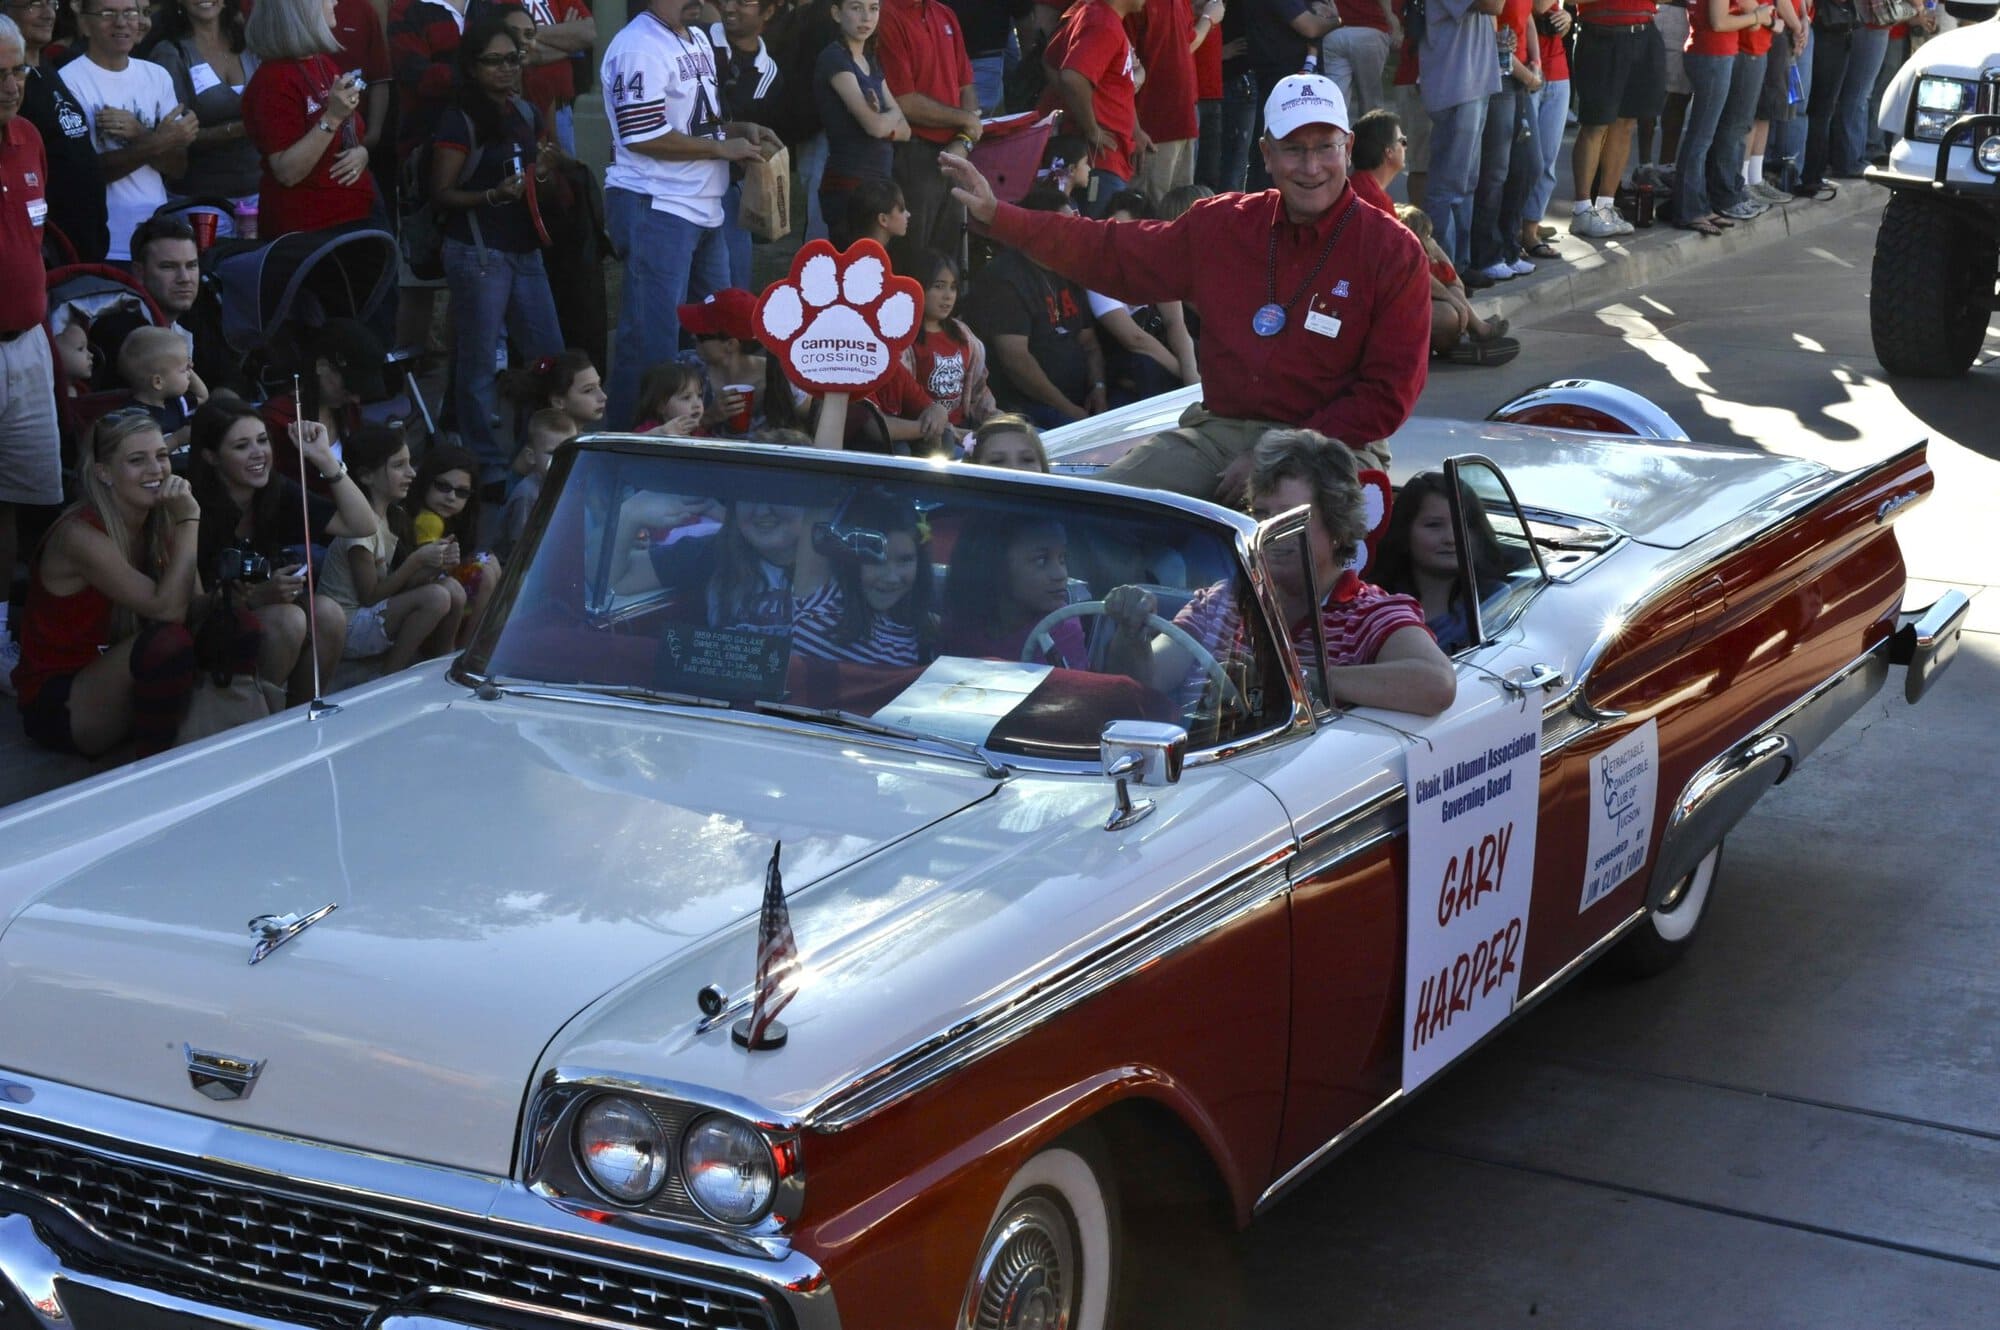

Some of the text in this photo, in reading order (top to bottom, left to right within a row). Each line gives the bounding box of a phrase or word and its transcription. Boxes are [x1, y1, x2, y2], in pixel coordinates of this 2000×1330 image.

[612, 70, 645, 102] 44
[801, 338, 865, 351] campus
[801, 350, 877, 367] crossings
[712, 632, 733, 642] FORD
[1443, 766, 1455, 792] UA
[1456, 751, 1487, 786] Alumni
[1487, 732, 1536, 771] Association
[1601, 741, 1645, 785] RETRACTABLE
[1604, 758, 1649, 807] CONVERTIBLE
[1441, 768, 1512, 824] Governing Board
[1628, 784, 1638, 801] OF
[1615, 803, 1642, 837] TUCSON
[1594, 828, 1644, 872] SPONSORED BY
[1601, 860, 1622, 892] CLICK
[1625, 845, 1645, 875] FORD
[1438, 821, 1513, 928] GARY
[1412, 917, 1522, 1052] HARPER
